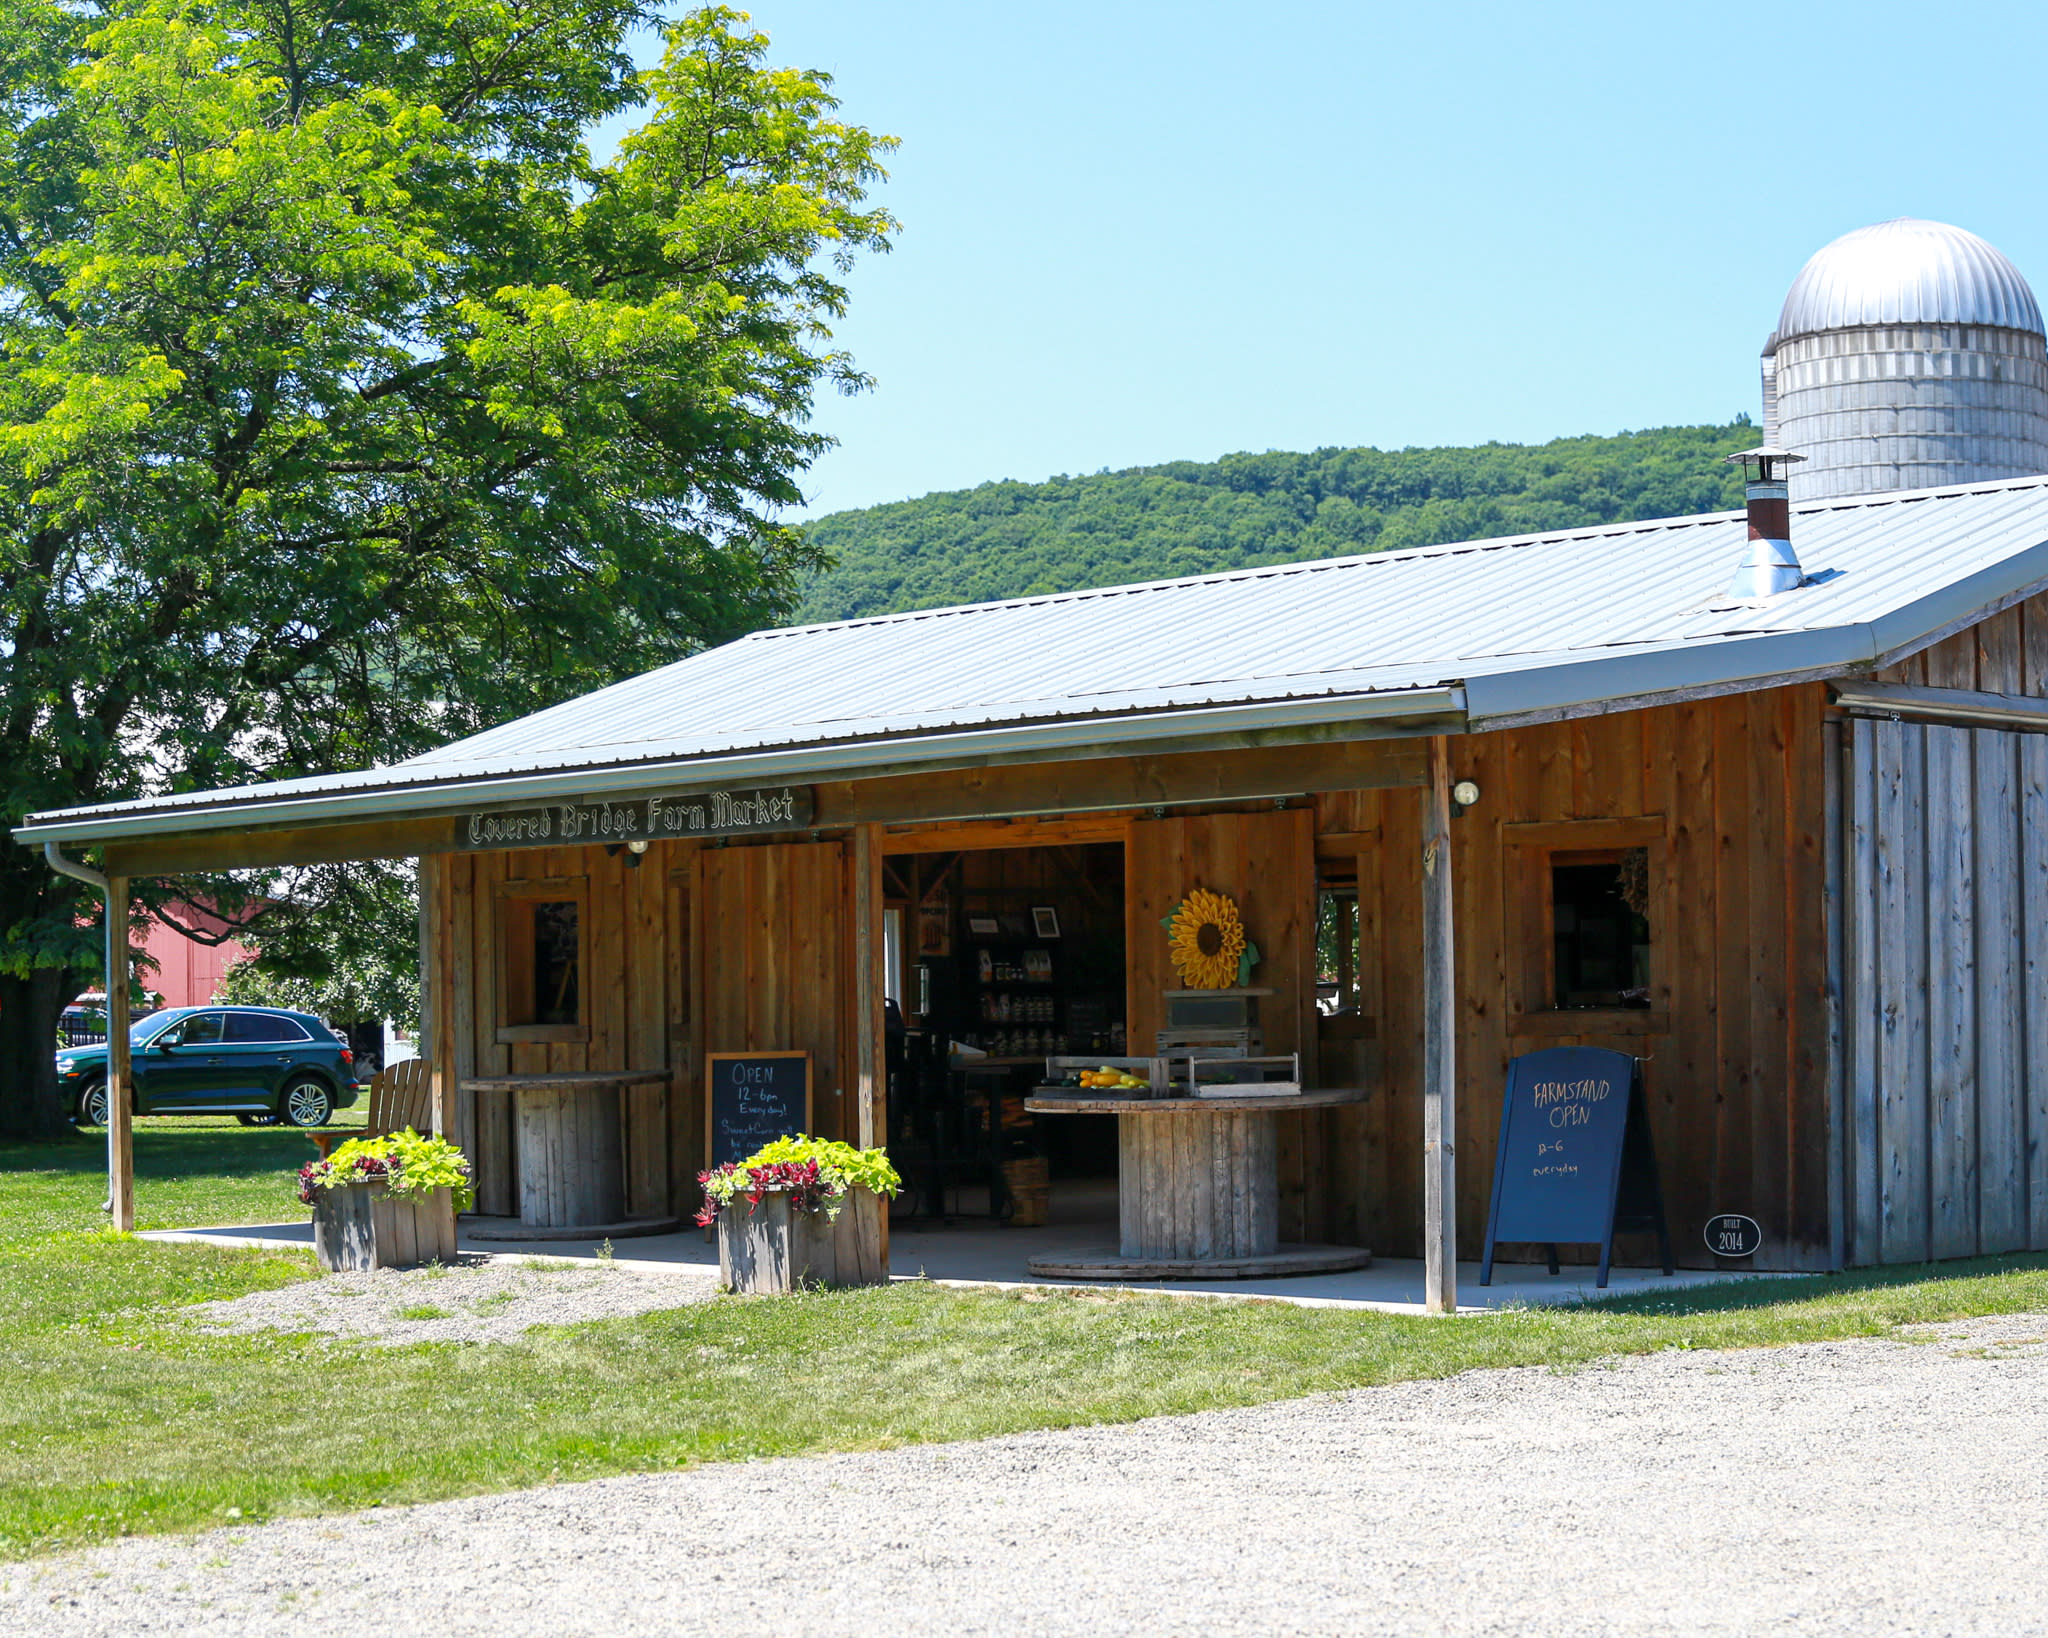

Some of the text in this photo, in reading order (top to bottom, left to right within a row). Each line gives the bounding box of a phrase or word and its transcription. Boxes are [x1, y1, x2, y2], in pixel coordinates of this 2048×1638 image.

[469, 787, 794, 845] Covered Bridge Farm Market
[732, 1063, 775, 1085] OPEN
[1533, 1079, 1611, 1109] FARMSTAND
[1549, 1103, 1591, 1129] OPEN
[1533, 1163, 1579, 1177] everyday
[1723, 1218, 1741, 1229] BUILT
[1719, 1232, 1744, 1250] 2014
